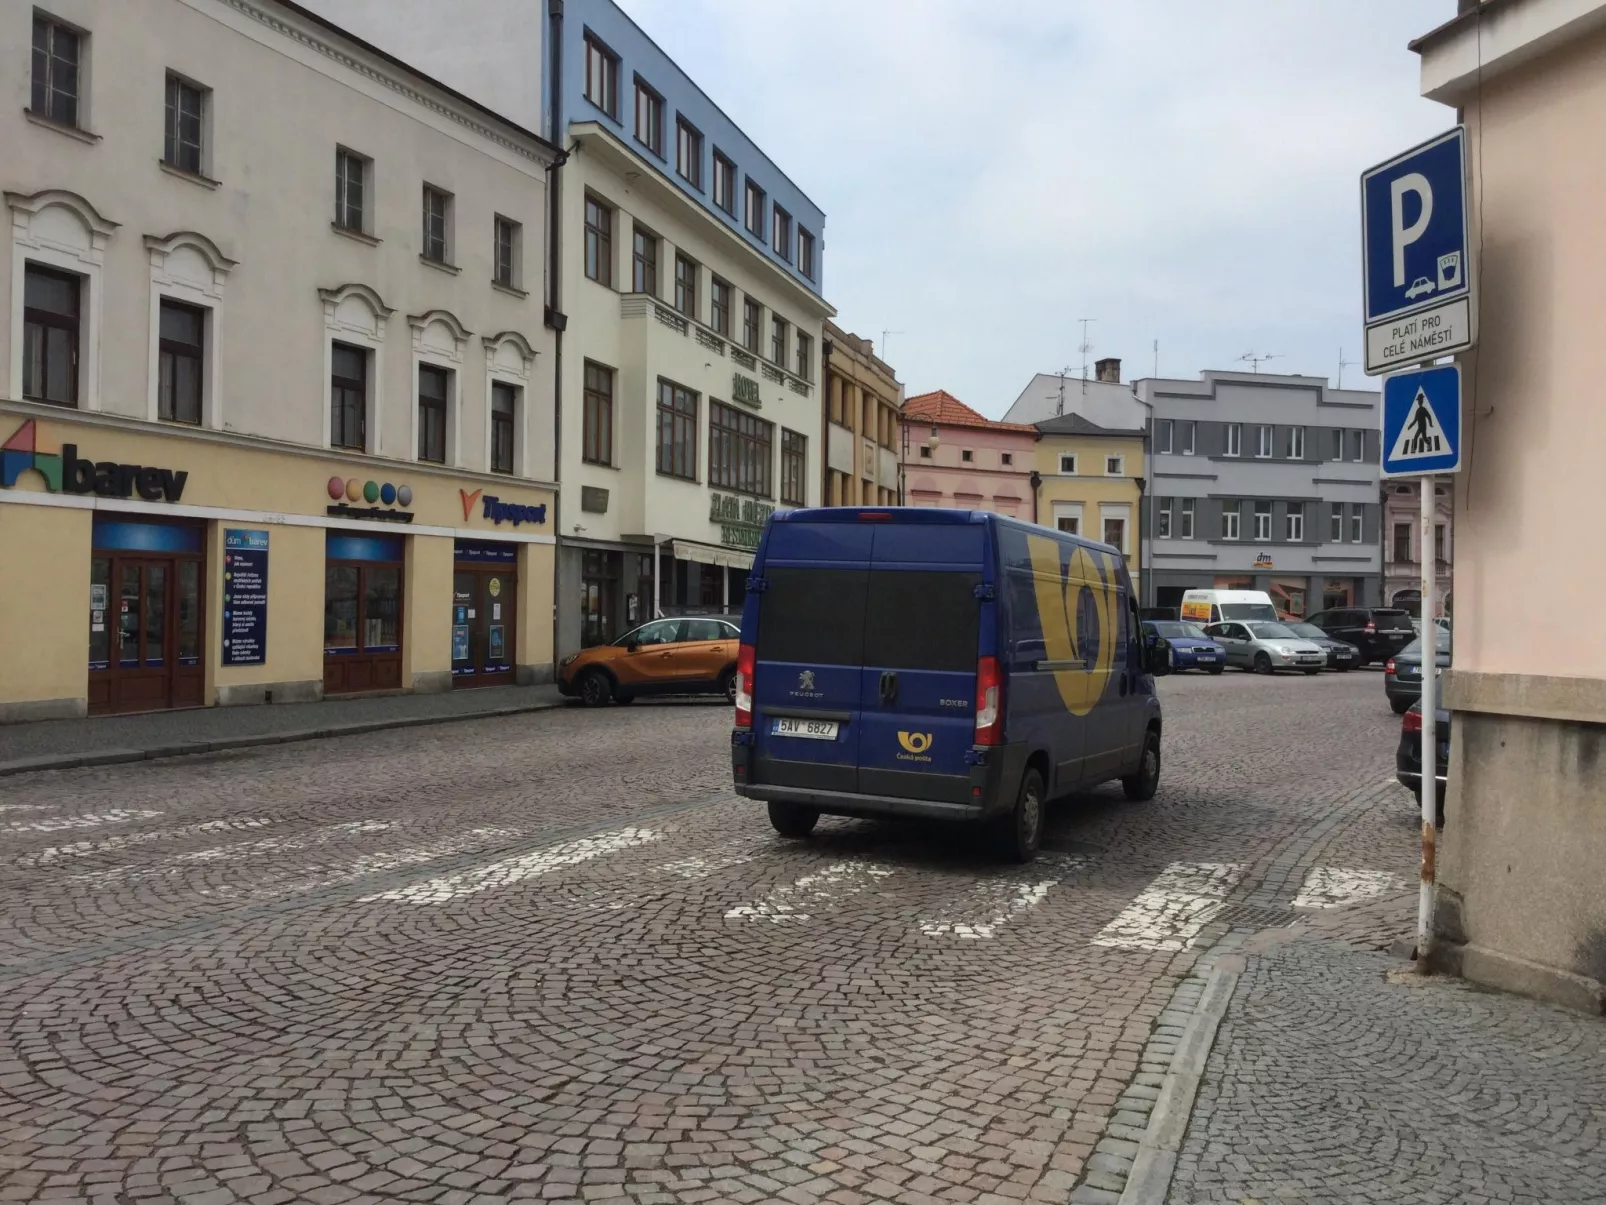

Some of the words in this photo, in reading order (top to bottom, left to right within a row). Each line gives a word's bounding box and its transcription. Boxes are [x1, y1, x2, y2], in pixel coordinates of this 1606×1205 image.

[1390, 172, 1434, 288] P
[1392, 317, 1418, 340] PLATÍ
[1421, 314, 1441, 334] PRO
[1383, 337, 1405, 359] CELÉ
[1409, 325, 1453, 353] NÁMĚSTÍ
[732, 372, 761, 404] HOTEL
[63, 443, 189, 502] barev
[227, 536, 241, 545] dům
[248, 536, 268, 547] barev
[1257, 552, 1272, 562] dm
[939, 698, 969, 708] BOXER
[780, 719, 800, 732] 5AV
[807, 721, 834, 735] 6827
[896, 751, 914, 761] Česká
[914, 753, 932, 763] pošta
